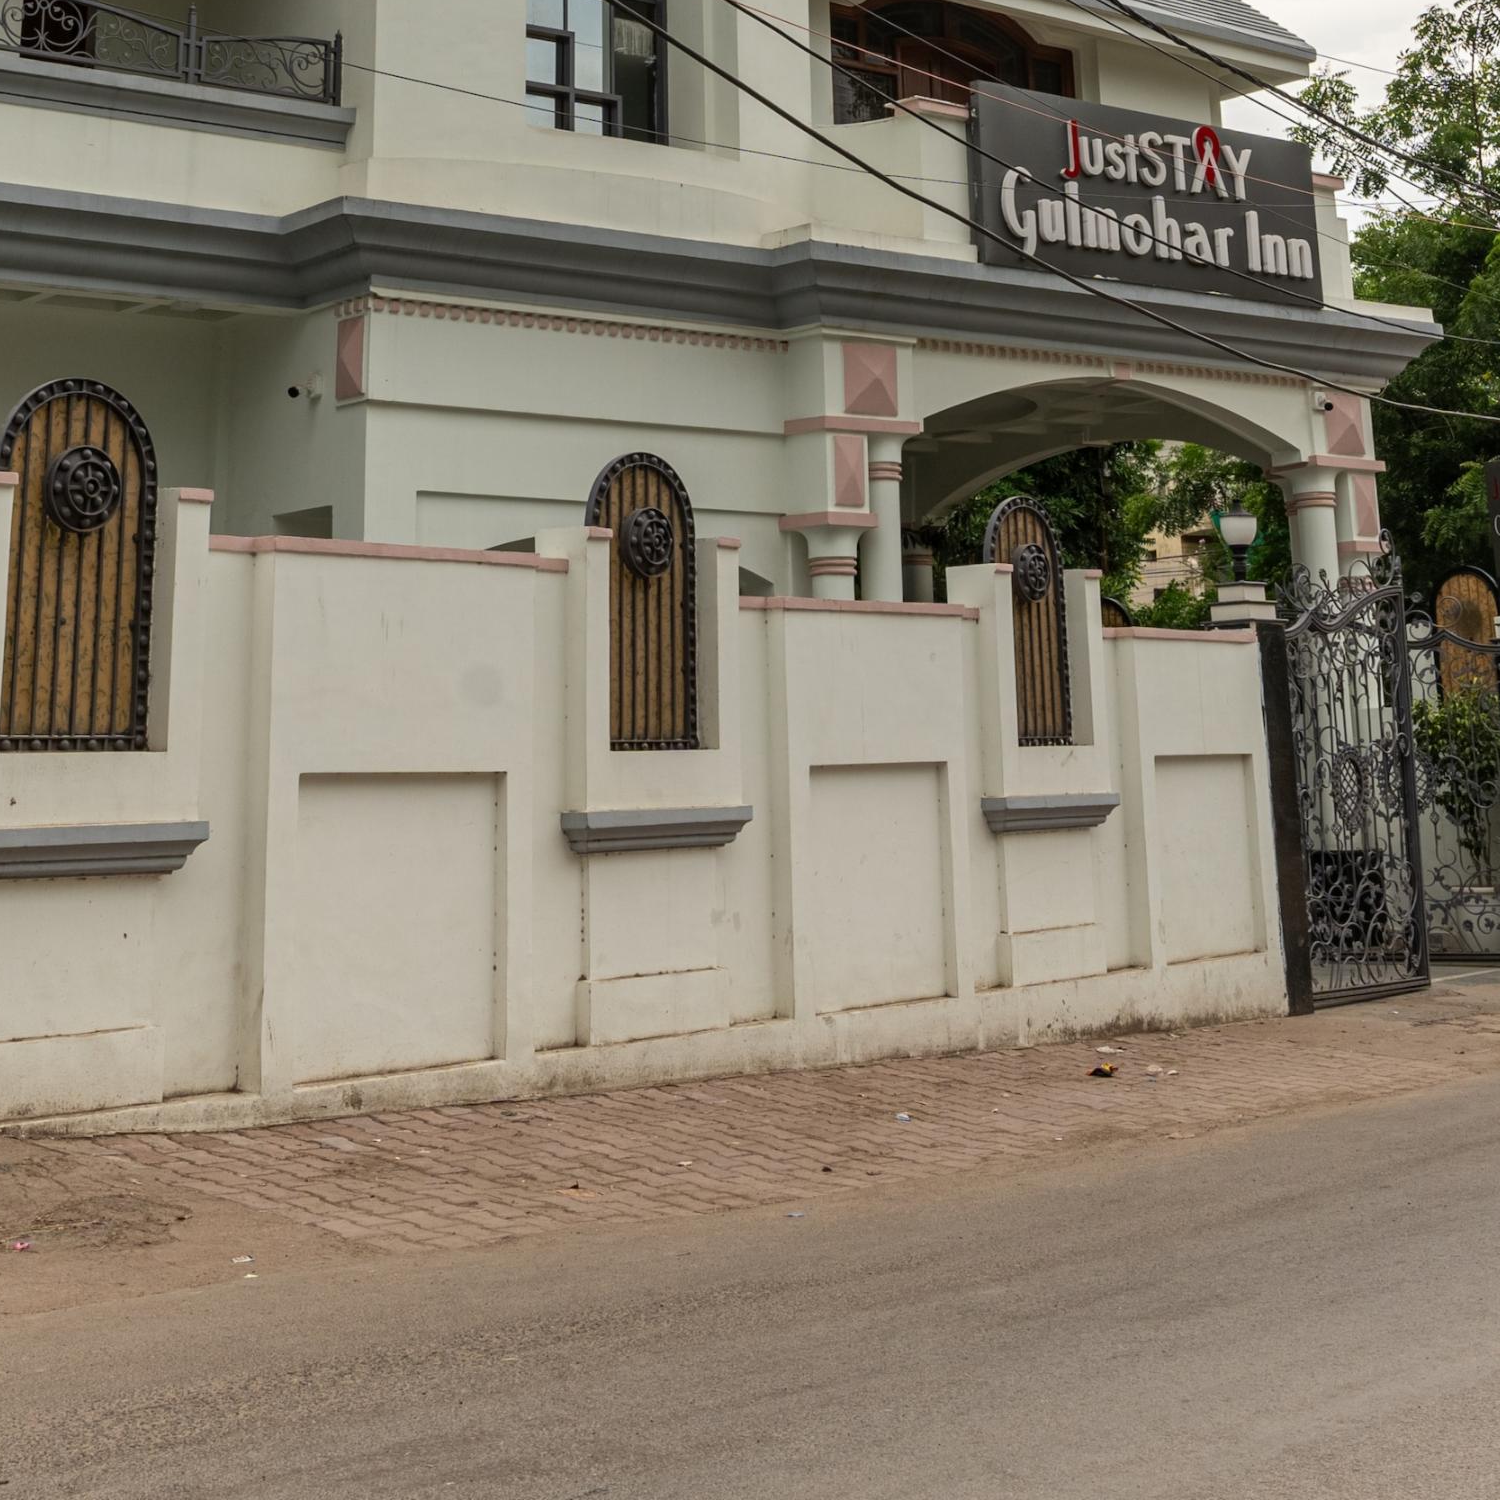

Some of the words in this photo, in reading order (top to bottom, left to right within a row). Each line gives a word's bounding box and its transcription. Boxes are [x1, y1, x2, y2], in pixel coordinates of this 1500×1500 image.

[1060, 119, 1252, 200] JustSTAY
[1001, 166, 1235, 267] Gulmohar
[1245, 210, 1314, 279] Inn
